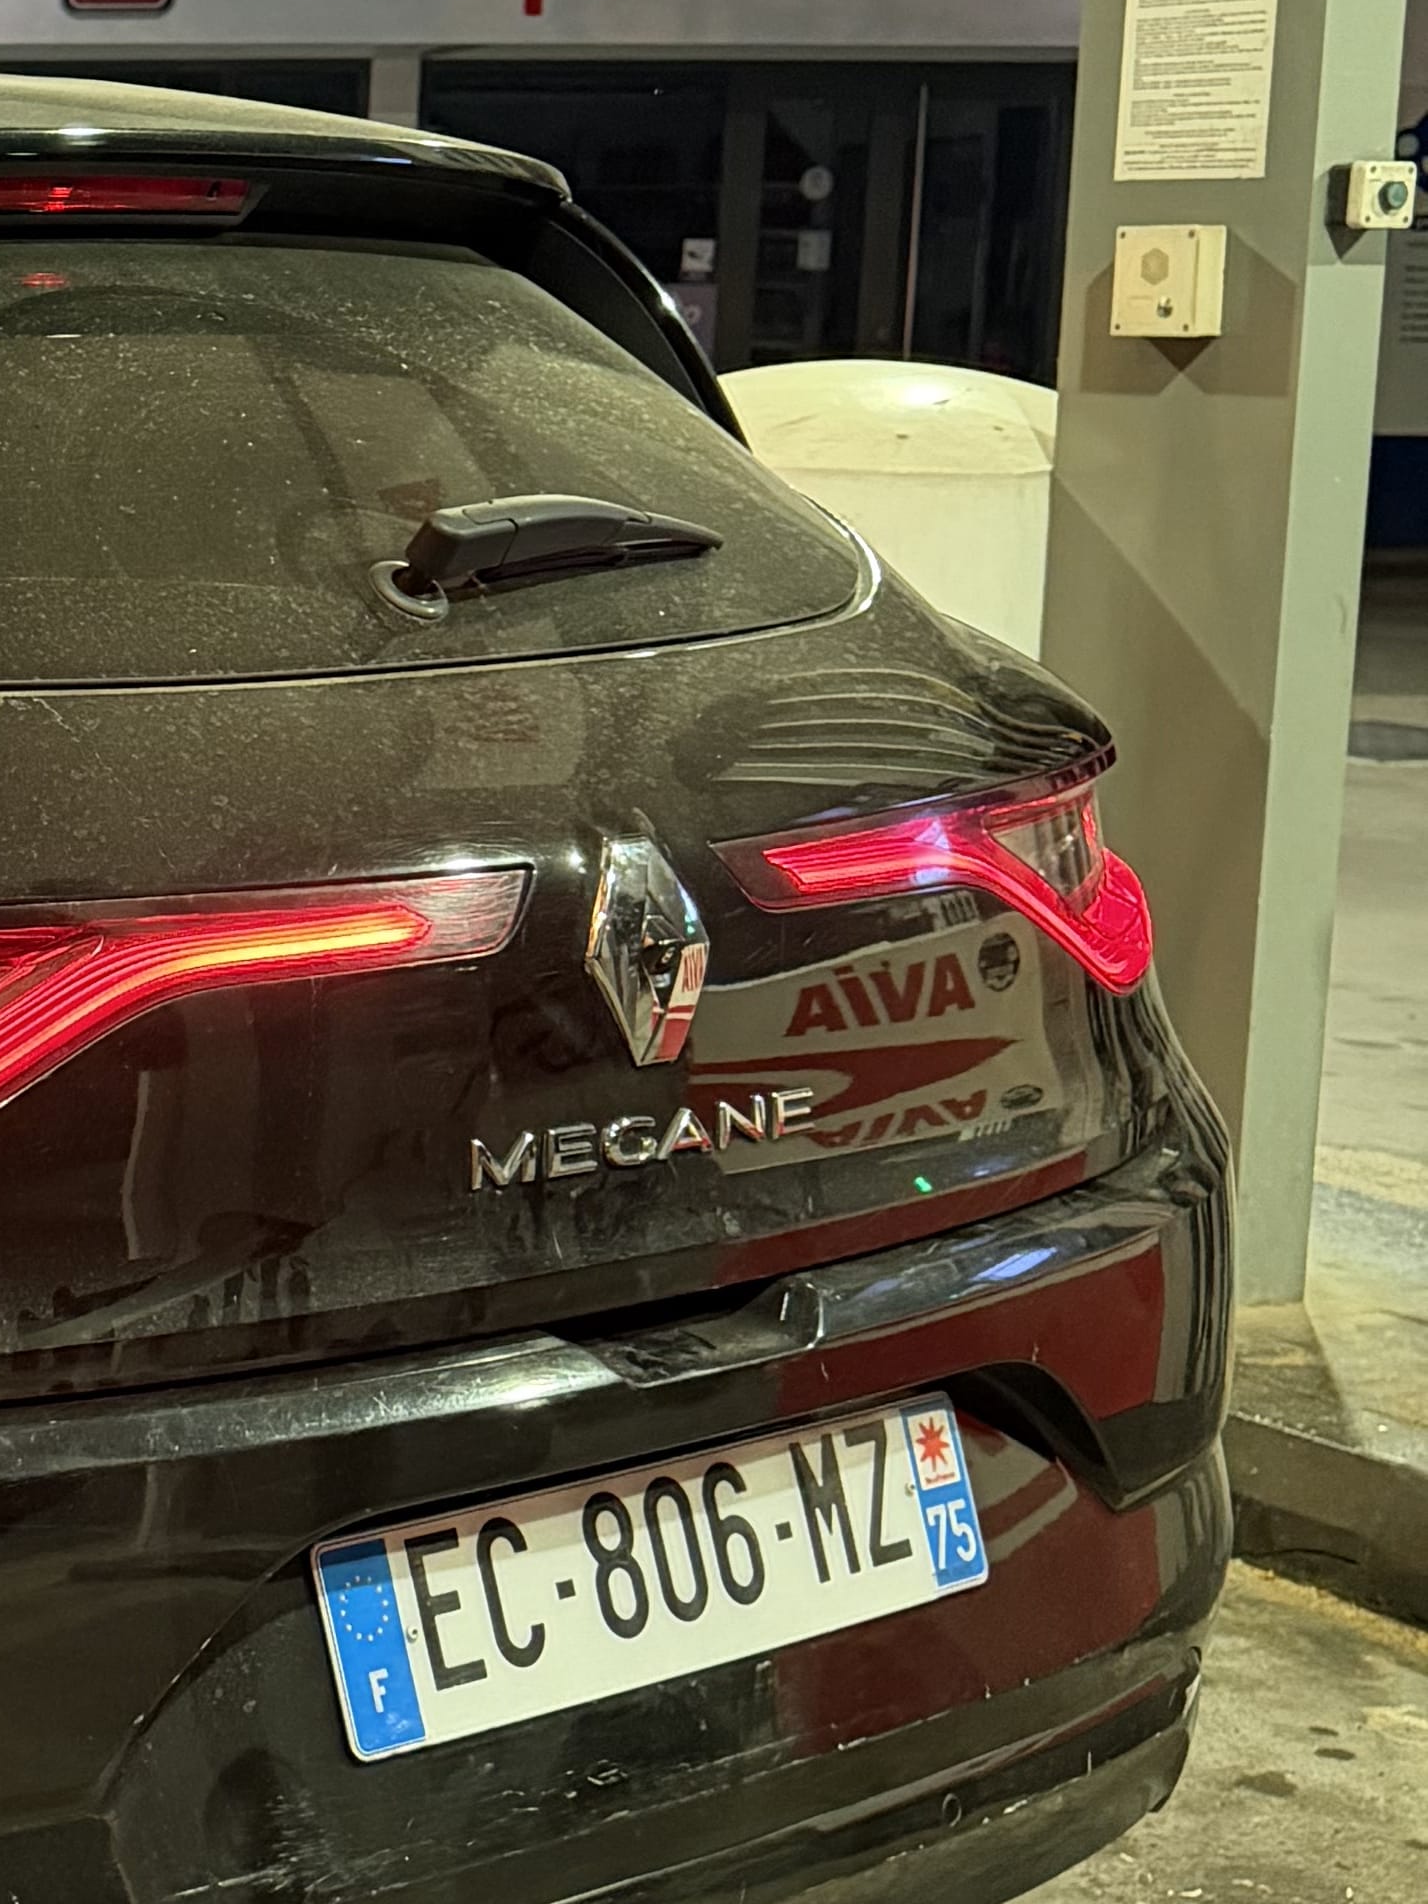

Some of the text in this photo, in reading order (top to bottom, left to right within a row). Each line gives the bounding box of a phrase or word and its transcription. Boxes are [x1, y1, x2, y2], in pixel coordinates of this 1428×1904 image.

[470, 1087, 815, 1191] MEGANE
[403, 1419, 914, 1691] EC-806-MZ
[925, 1497, 978, 1571] 75
[367, 1667, 389, 1714] F
